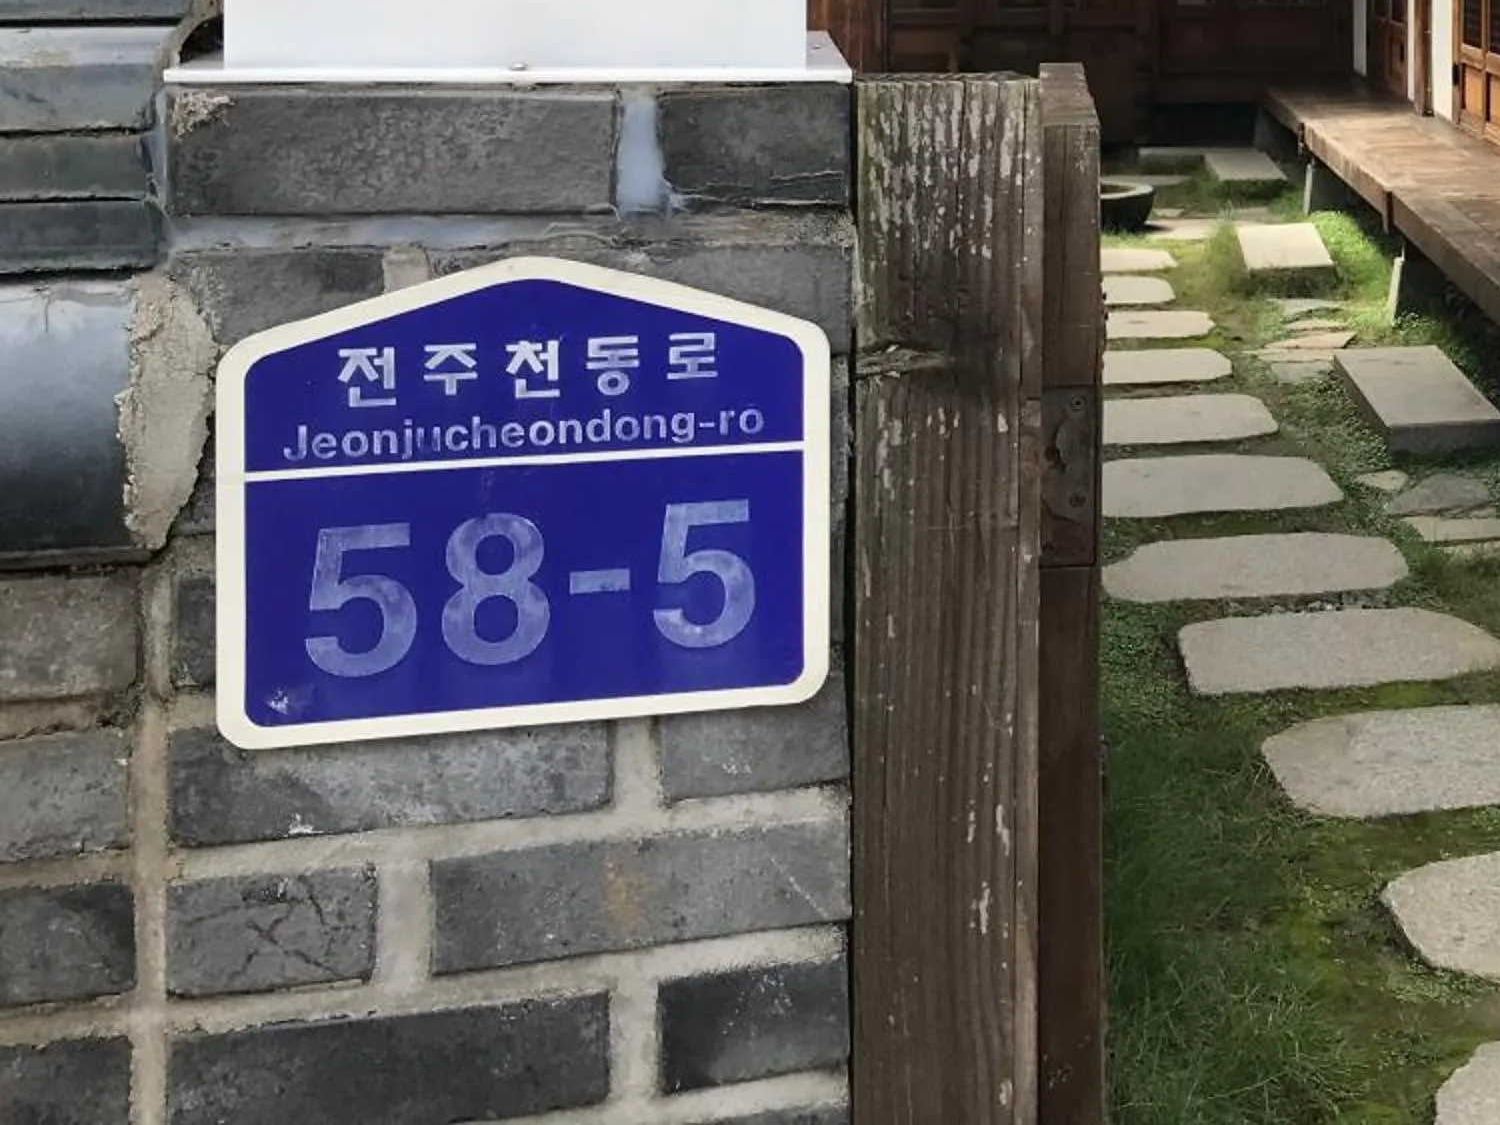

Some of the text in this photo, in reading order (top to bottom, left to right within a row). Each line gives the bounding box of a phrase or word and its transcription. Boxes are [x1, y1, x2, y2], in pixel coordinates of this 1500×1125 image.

[338, 331, 719, 408] 전주천동로
[283, 405, 765, 462] Jeonjucheondong-ro
[304, 498, 756, 678] 58-5
